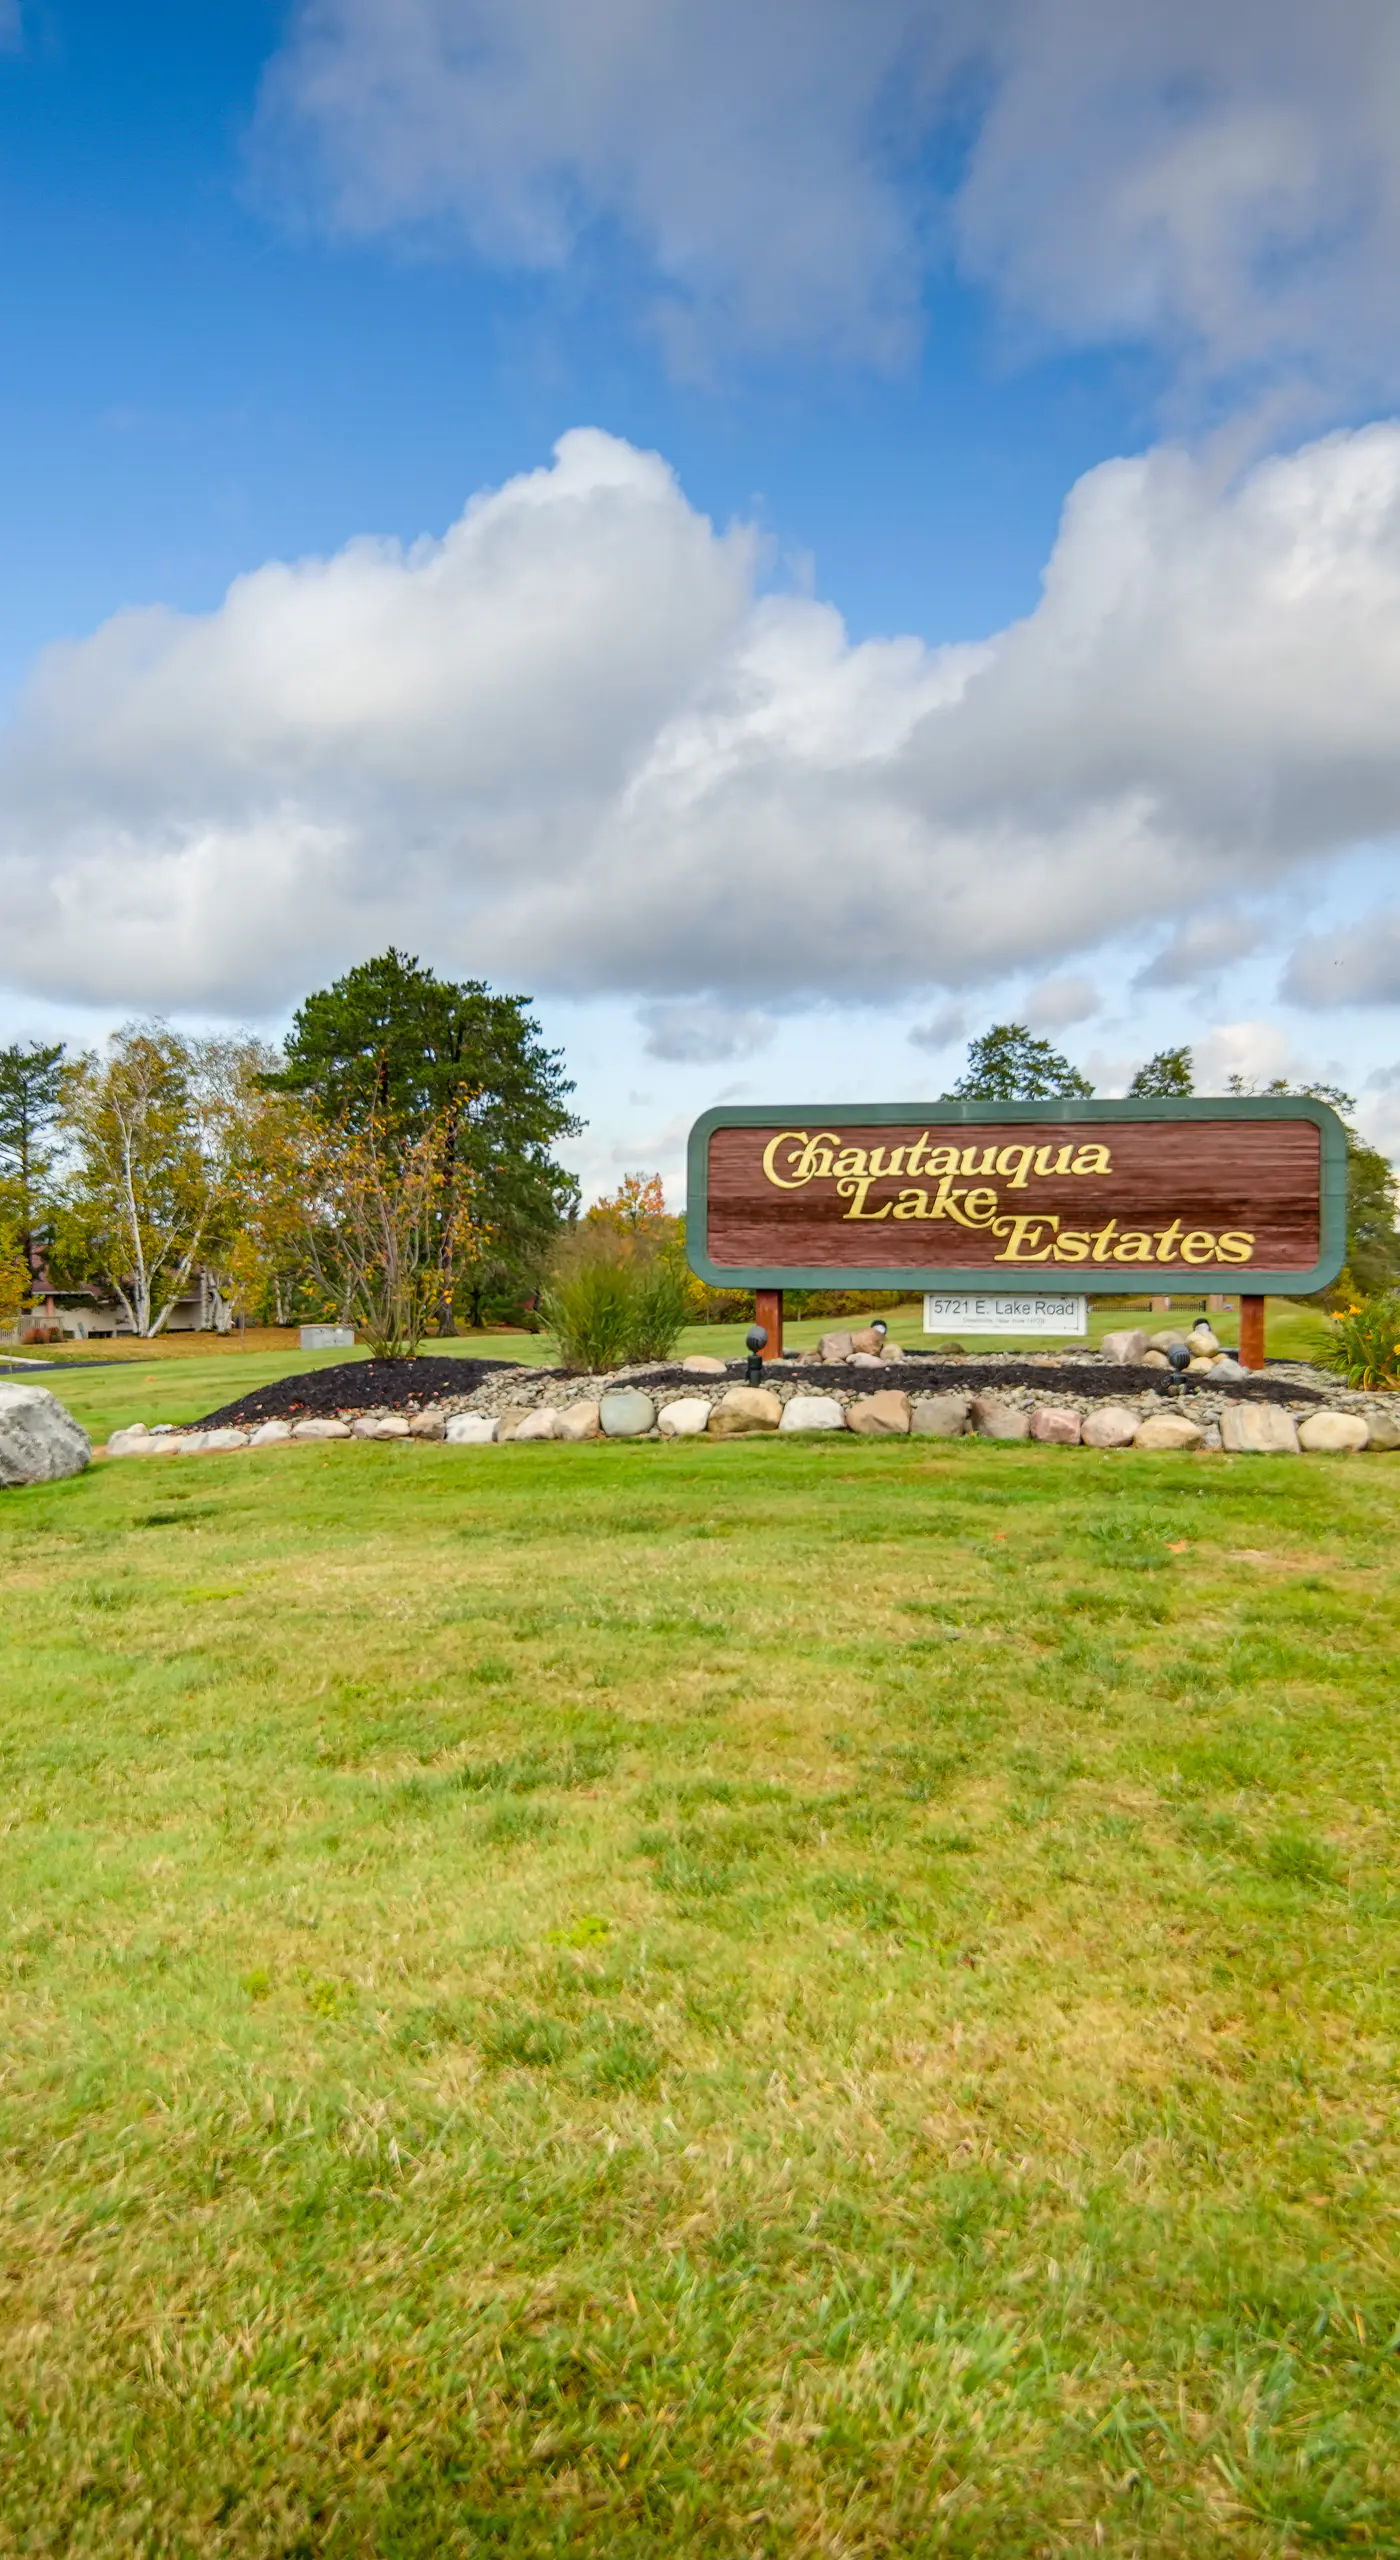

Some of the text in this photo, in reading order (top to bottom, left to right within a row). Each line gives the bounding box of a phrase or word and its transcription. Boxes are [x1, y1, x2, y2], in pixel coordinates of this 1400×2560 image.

[762, 1131, 1113, 1189] Chautauqua
[836, 1175, 998, 1228] Lake
[991, 1215, 1256, 1264] Estates
[934, 1300, 1074, 1315] 5721 E. Lake Road
